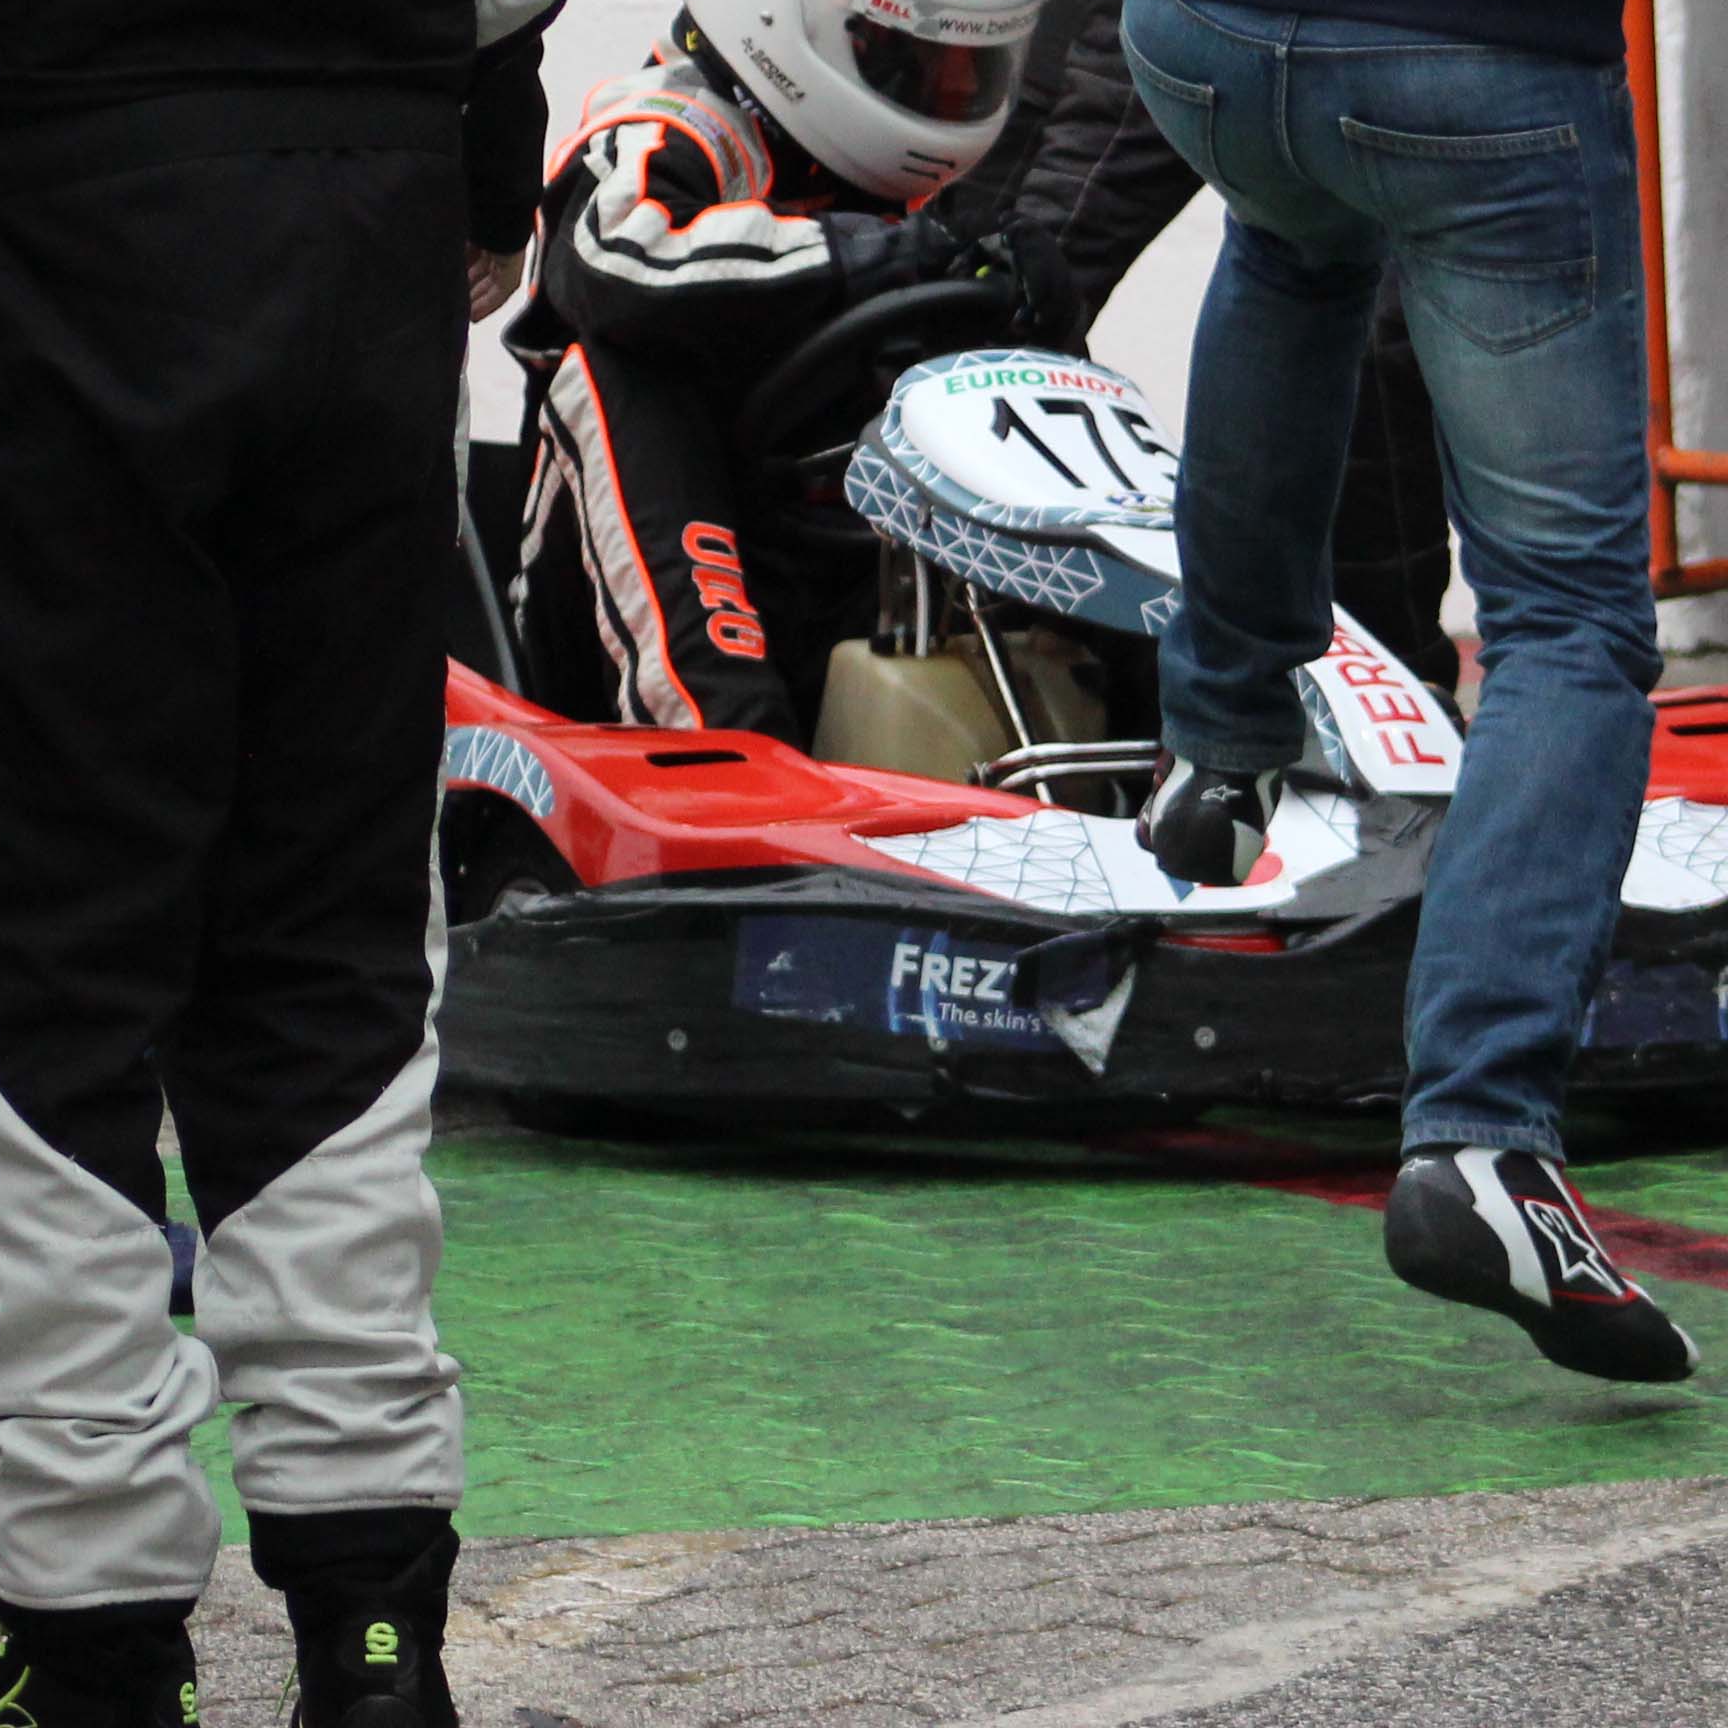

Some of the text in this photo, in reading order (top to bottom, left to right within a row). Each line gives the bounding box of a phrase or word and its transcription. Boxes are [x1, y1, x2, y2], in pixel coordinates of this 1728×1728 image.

[945, 368, 1125, 399] EUROINDY
[889, 942, 1020, 1002] FREZ
[938, 1002, 978, 1026] The
[981, 1011, 1042, 1034] skin's
